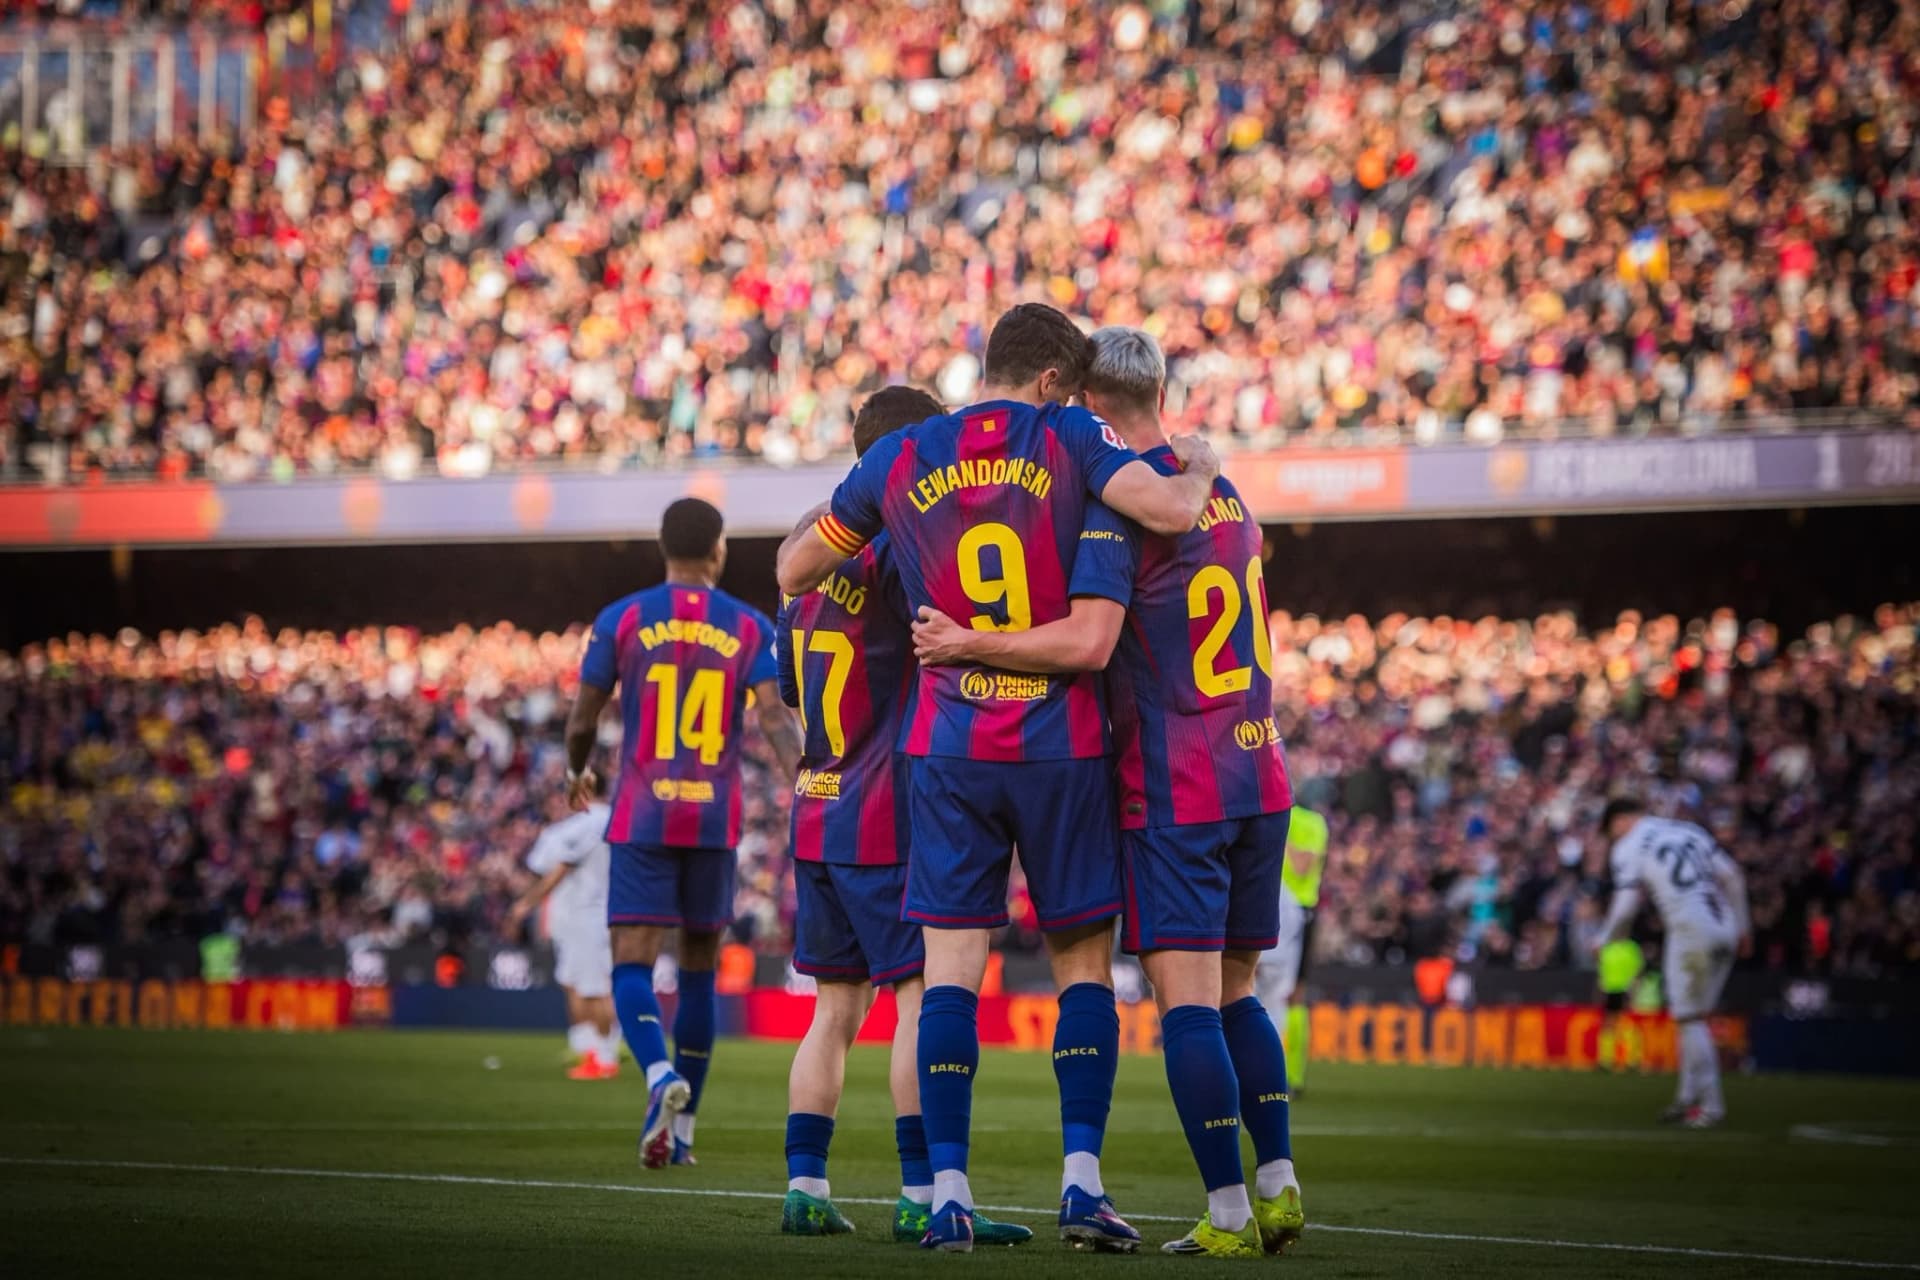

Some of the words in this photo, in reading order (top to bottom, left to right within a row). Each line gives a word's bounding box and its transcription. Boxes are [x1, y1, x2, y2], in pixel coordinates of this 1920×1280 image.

[907, 457, 1052, 514] LEWANDOWSKI
[957, 521, 1032, 634] 9
[646, 663, 726, 766] 14
[791, 629, 855, 758] 17
[995, 673, 1049, 688] UNHCR
[995, 685, 1048, 698] ACNUR
